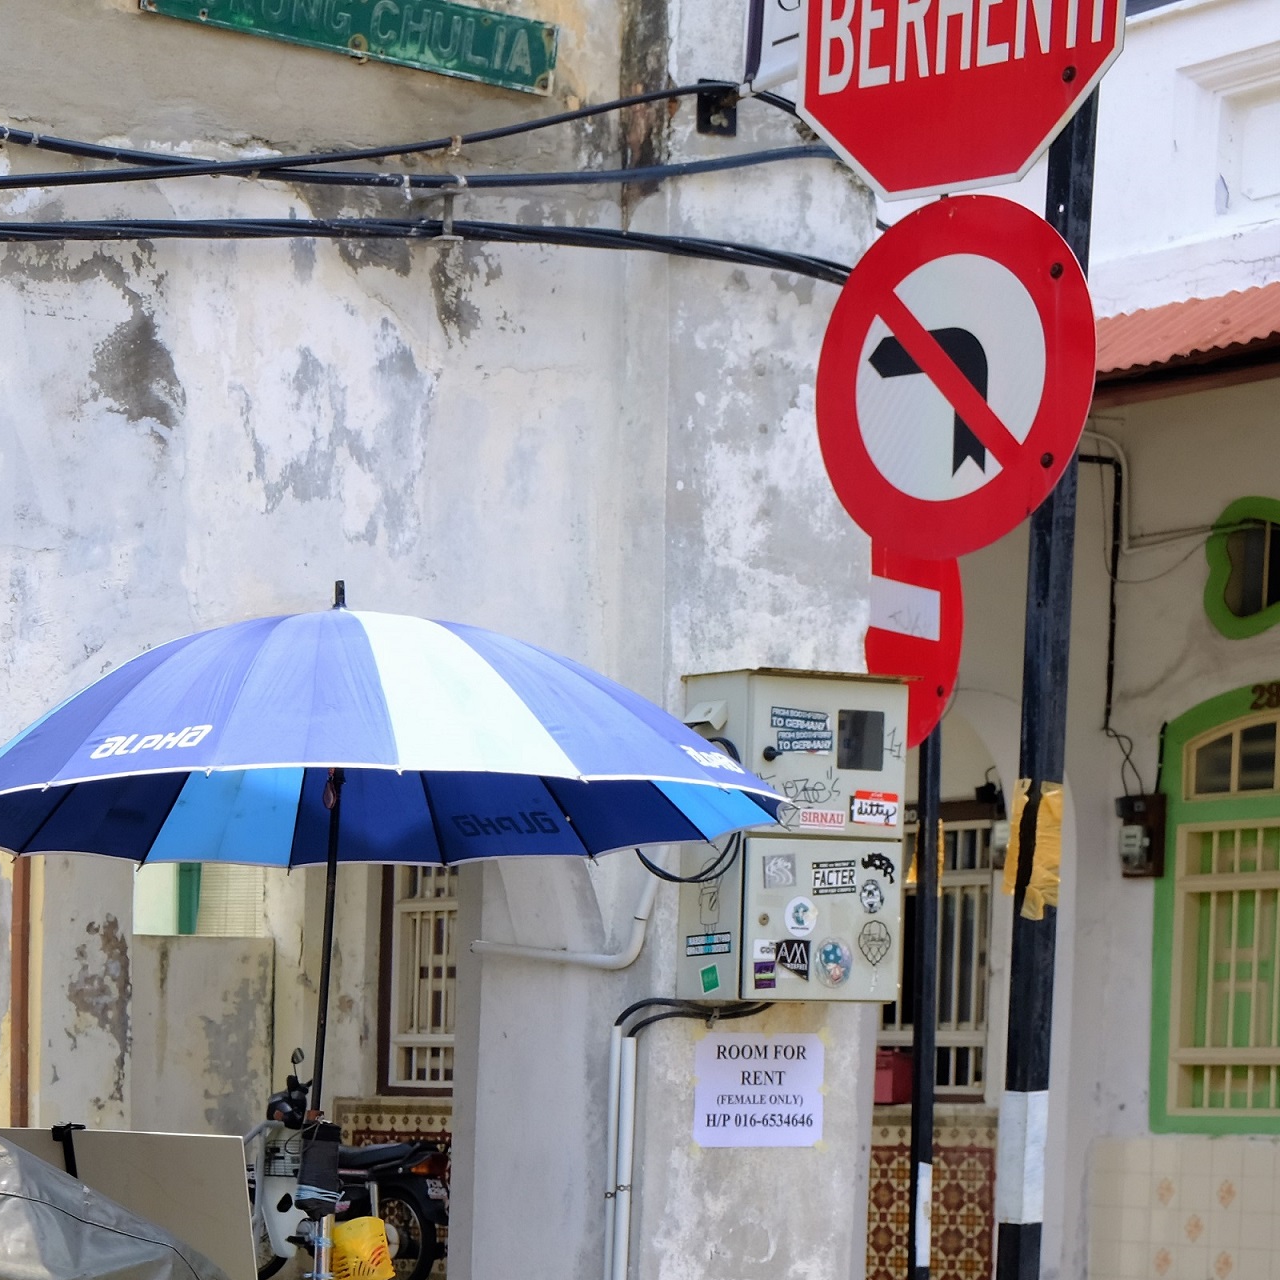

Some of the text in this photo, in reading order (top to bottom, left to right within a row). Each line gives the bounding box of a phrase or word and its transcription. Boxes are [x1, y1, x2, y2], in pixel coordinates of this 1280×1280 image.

[370, 1, 532, 76] CHULIA
[772, 717, 826, 730] TO GERMANY
[778, 740, 831, 750] TO GERMANY
[801, 811, 844, 824] SIRNAU
[857, 801, 897, 825] ditty
[813, 869, 855, 886] FACTER
[716, 1044, 807, 1060] ROOM FOR
[741, 1070, 786, 1085] RENT
[716, 1094, 803, 1107] (FEMALE ONLY)
[706, 1113, 813, 1127] H/P 016-6534646
